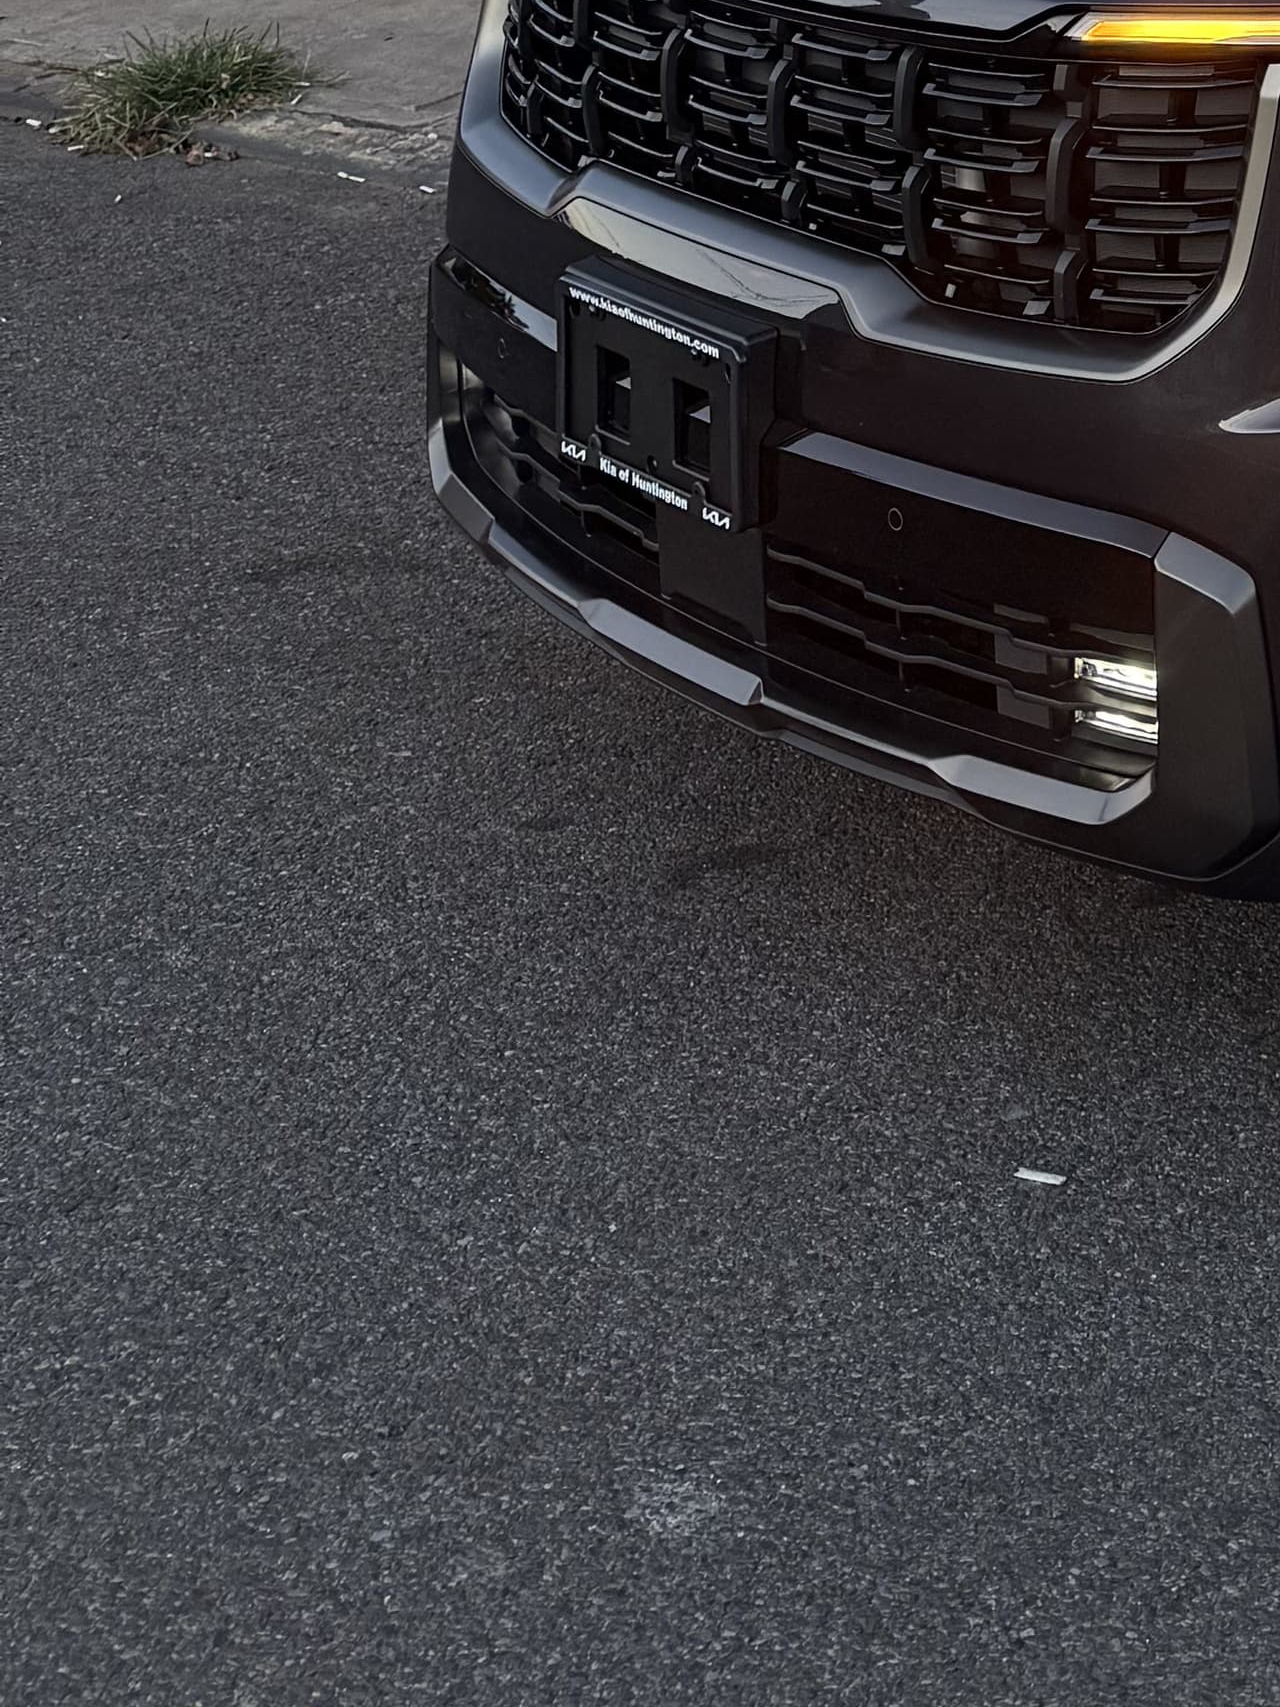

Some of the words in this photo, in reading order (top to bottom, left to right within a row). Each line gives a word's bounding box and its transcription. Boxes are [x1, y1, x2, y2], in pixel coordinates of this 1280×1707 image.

[568, 286, 720, 360] www.kiaofhuntington.com
[560, 439, 587, 463] KIA
[599, 456, 617, 479] Kia
[618, 468, 630, 484] of
[631, 471, 689, 512] Huntington
[702, 505, 732, 531] KIA
